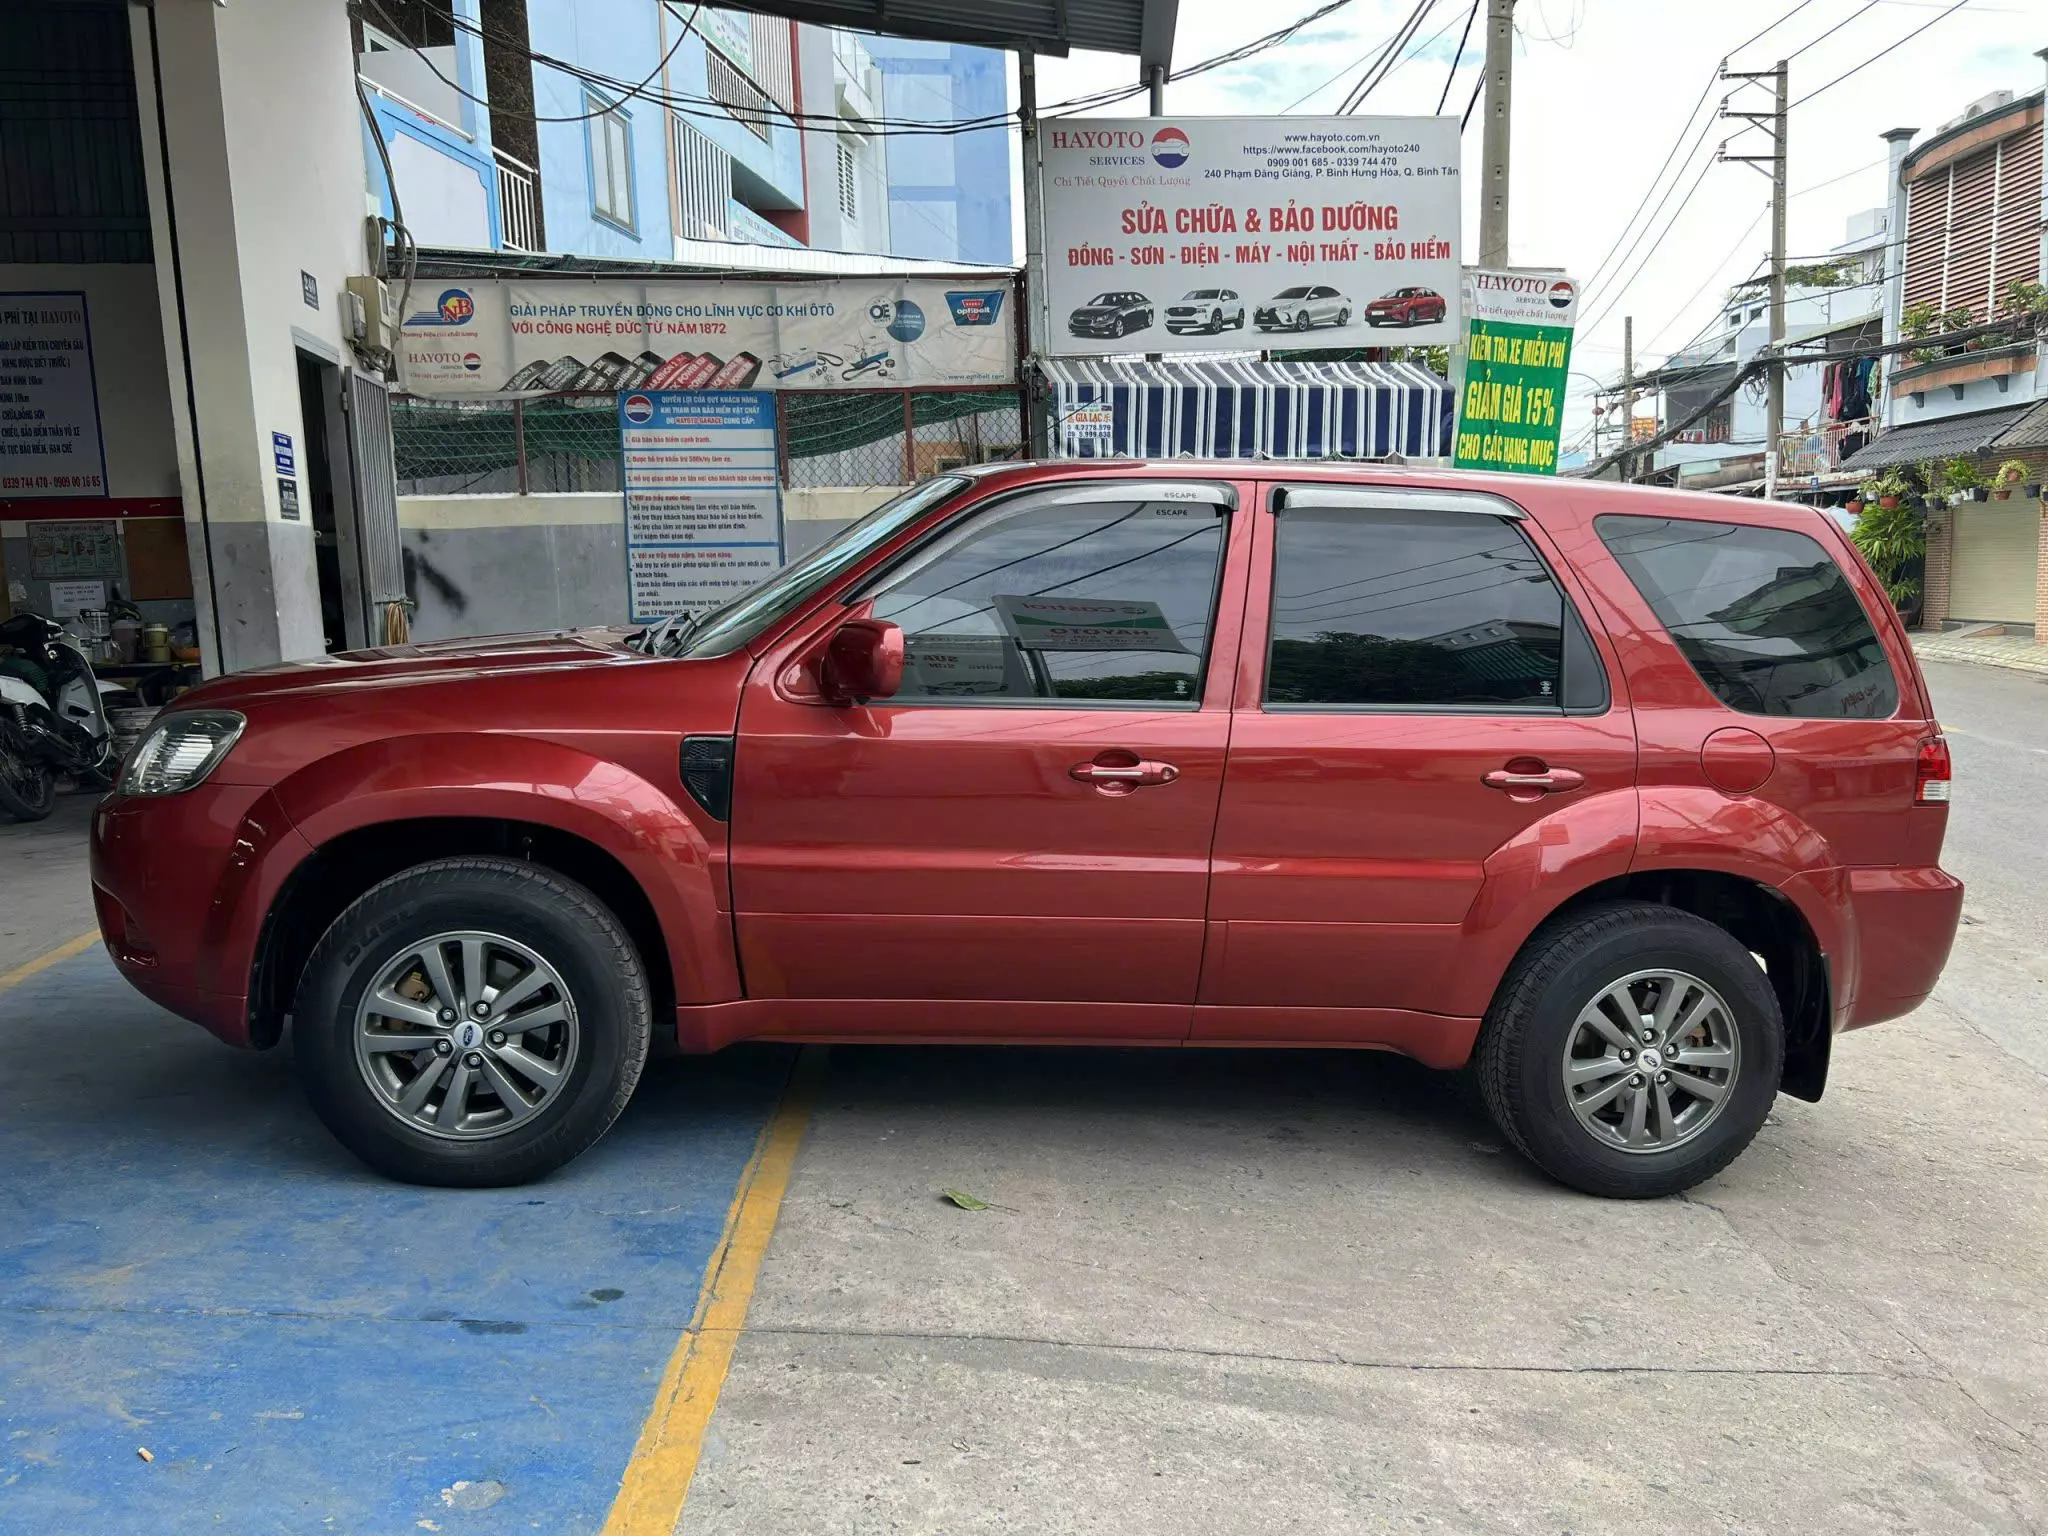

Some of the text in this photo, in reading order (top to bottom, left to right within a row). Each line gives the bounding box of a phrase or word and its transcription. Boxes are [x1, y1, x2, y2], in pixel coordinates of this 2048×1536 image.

[1052, 131, 1144, 149] HAYOTO
[1284, 133, 1380, 143] www.hayoto.com.vn
[1243, 144, 1420, 155] https://www.facebook.com/hayoto240
[1089, 156, 1145, 165] SERVICES
[1267, 158, 1290, 167] 0909
[1292, 158, 1308, 167] 001
[1311, 158, 1328, 167] 685
[1337, 157, 1359, 166] 0339
[1362, 157, 1378, 166] 744
[1380, 157, 1397, 166] 470
[1204, 169, 1221, 178] 240
[1224, 169, 1251, 180] Phạm
[1315, 168, 1325, 177] P.
[1326, 168, 1348, 177] Bình
[1351, 168, 1378, 179] Hưng
[1403, 167, 1414, 176] Q.
[1417, 167, 1439, 176] Bình
[1441, 166, 1459, 175] Tân
[1121, 199, 1398, 234] SỬA CHỮA & BẢO DƯỠNG
[1067, 241, 1114, 267] ĐỒNG
[1130, 245, 1164, 265] SƠN
[1181, 243, 1219, 268] ĐIỆN
[1235, 241, 1271, 263] MÁY
[1287, 240, 1315, 266] NỘI
[1320, 237, 1359, 262] THẤT
[1374, 237, 1405, 261] BẢO
[1410, 234, 1450, 259] HIỂM
[1477, 274, 1547, 294] HAYOTO
[1515, 297, 1546, 305] SERVICES
[510, 301, 835, 319] GIẢI PHÁP TRUYỀN ĐỘNG CHO LĨNH VỰC CƠ KHÍ ÔTÔ
[869, 303, 890, 320] OE
[956, 306, 990, 315] optibelt
[1477, 304, 1568, 321] Chi tiết quyết chất lượng
[512, 319, 727, 336] VỚI CÔNG NGHỆ ĐỨC TỪ NĂM 1872
[409, 353, 461, 363] HAYOTO
[1494, 336, 1508, 364] TRA
[1508, 339, 1522, 365] XE
[1547, 336, 1567, 368] PHÍ
[947, 371, 1005, 380] www.optibelt.com
[661, 394, 758, 404] QUYỀN LỢI CỦA QUÝ KHÁCH HÀNG
[1503, 377, 1523, 423] GIÁ
[1525, 388, 1555, 426] 15%
[660, 405, 760, 414] KHI THAM GIA BẢO HIỂM VẬT CHẤT
[666, 416, 756, 425] DO HAYOTO GARAGE CUNG CẤP:
[1458, 433, 1480, 460] CHO
[1483, 429, 1502, 462] CÁC
[1529, 439, 1554, 471] MỤC
[3, 477, 20, 489] 0339
[21, 477, 34, 488] 744
[35, 476, 48, 488] 470
[53, 476, 71, 488] 0909
[71, 476, 81, 488] 00
[82, 475, 91, 487] 16
[92, 475, 101, 487] 85
